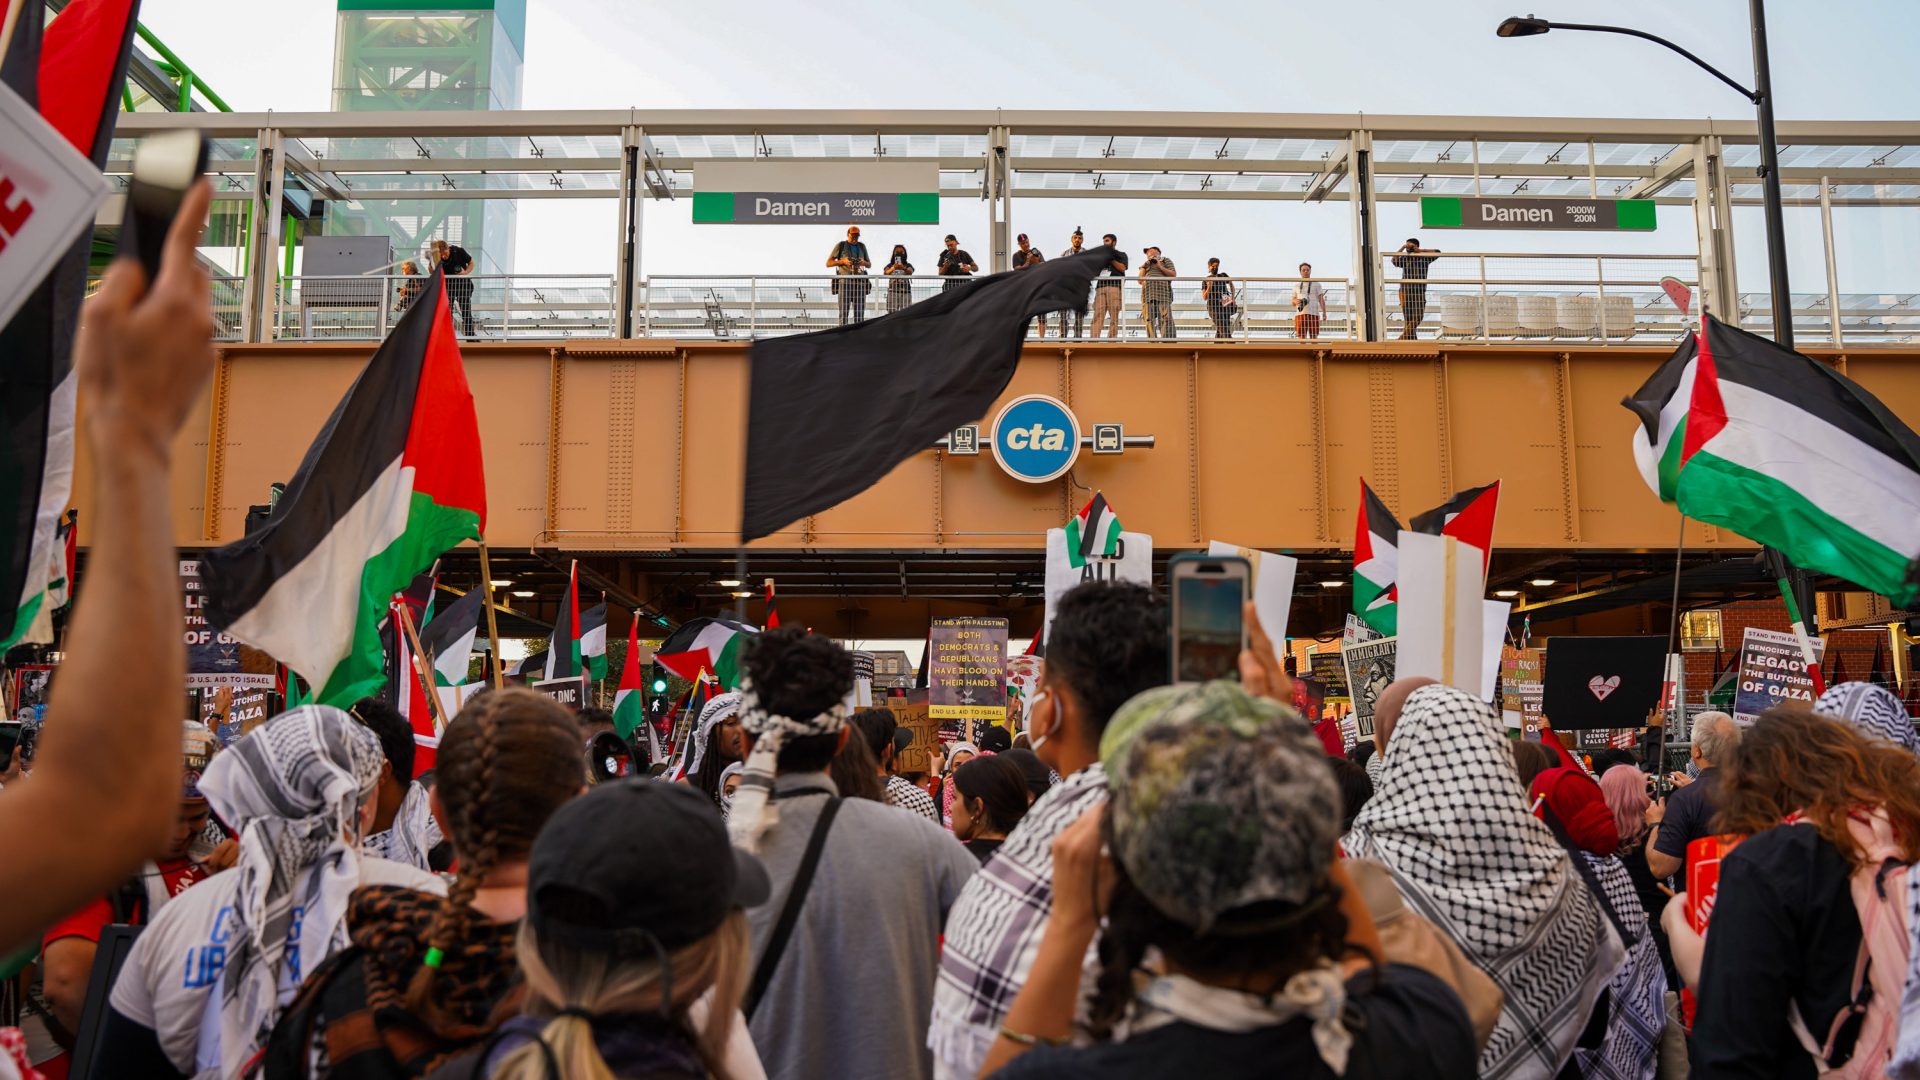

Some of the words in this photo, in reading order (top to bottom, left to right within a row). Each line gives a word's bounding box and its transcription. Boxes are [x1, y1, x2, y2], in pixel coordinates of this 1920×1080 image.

[755, 198, 830, 216] Damen
[844, 200, 875, 208] 2000W
[852, 208, 875, 216] 200N
[1481, 204, 1553, 222] Damen
[1566, 206, 1595, 214] 2000W
[1007, 424, 1065, 451] cta
[184, 631, 211, 644] OF
[1748, 631, 1769, 639] STAND
[1788, 637, 1822, 646] PALINE
[1347, 641, 1396, 662] IMMIGRANT
[1748, 644, 1790, 655] GENOCIDE
[1746, 654, 1808, 672] LEGACY
[1744, 669, 1764, 678] THE
[1767, 672, 1813, 686] BUTCHER
[558, 689, 576, 703] DNC
[1742, 681, 1764, 692] OF
[1768, 685, 1812, 701] GAZA
[229, 706, 263, 723] GAZA
